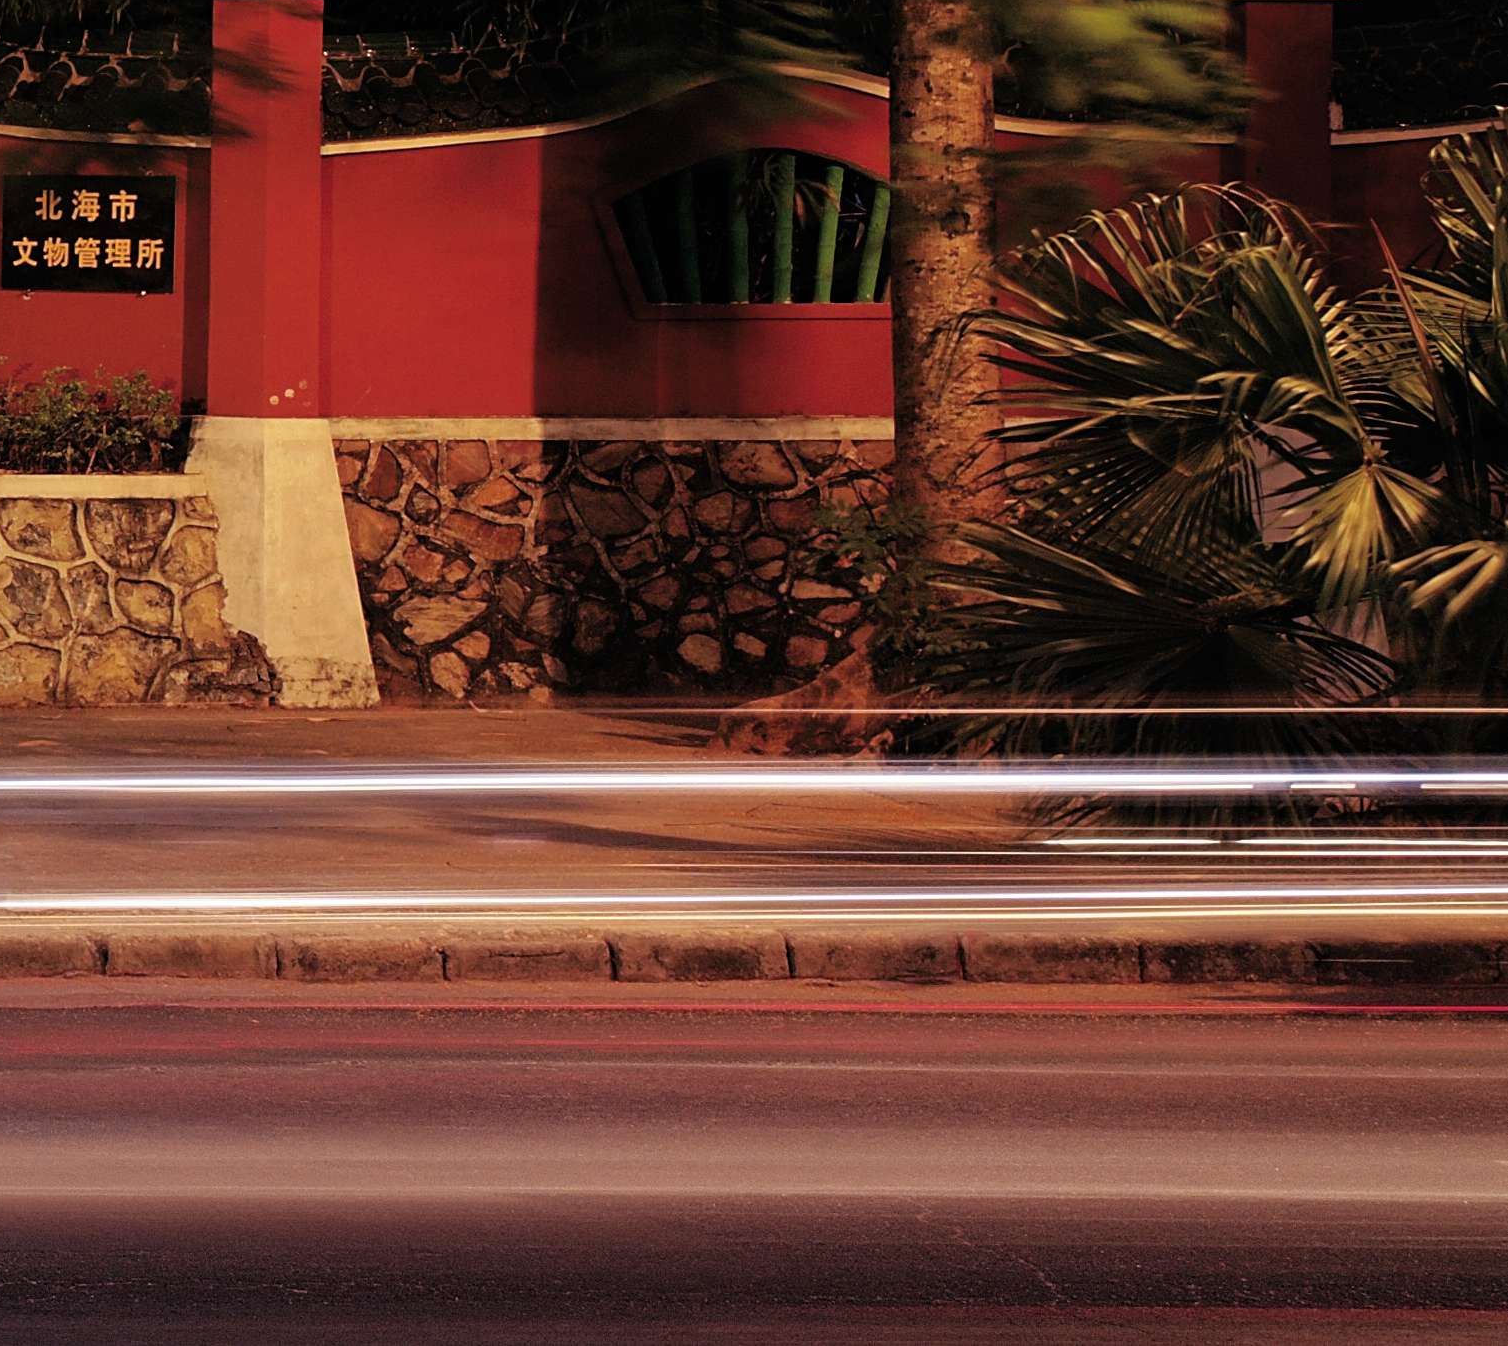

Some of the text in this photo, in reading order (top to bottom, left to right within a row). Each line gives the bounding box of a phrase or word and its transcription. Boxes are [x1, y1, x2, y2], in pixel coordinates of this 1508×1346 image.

[36, 190, 137, 223] 北海市
[13, 238, 165, 270] 文物管理所
